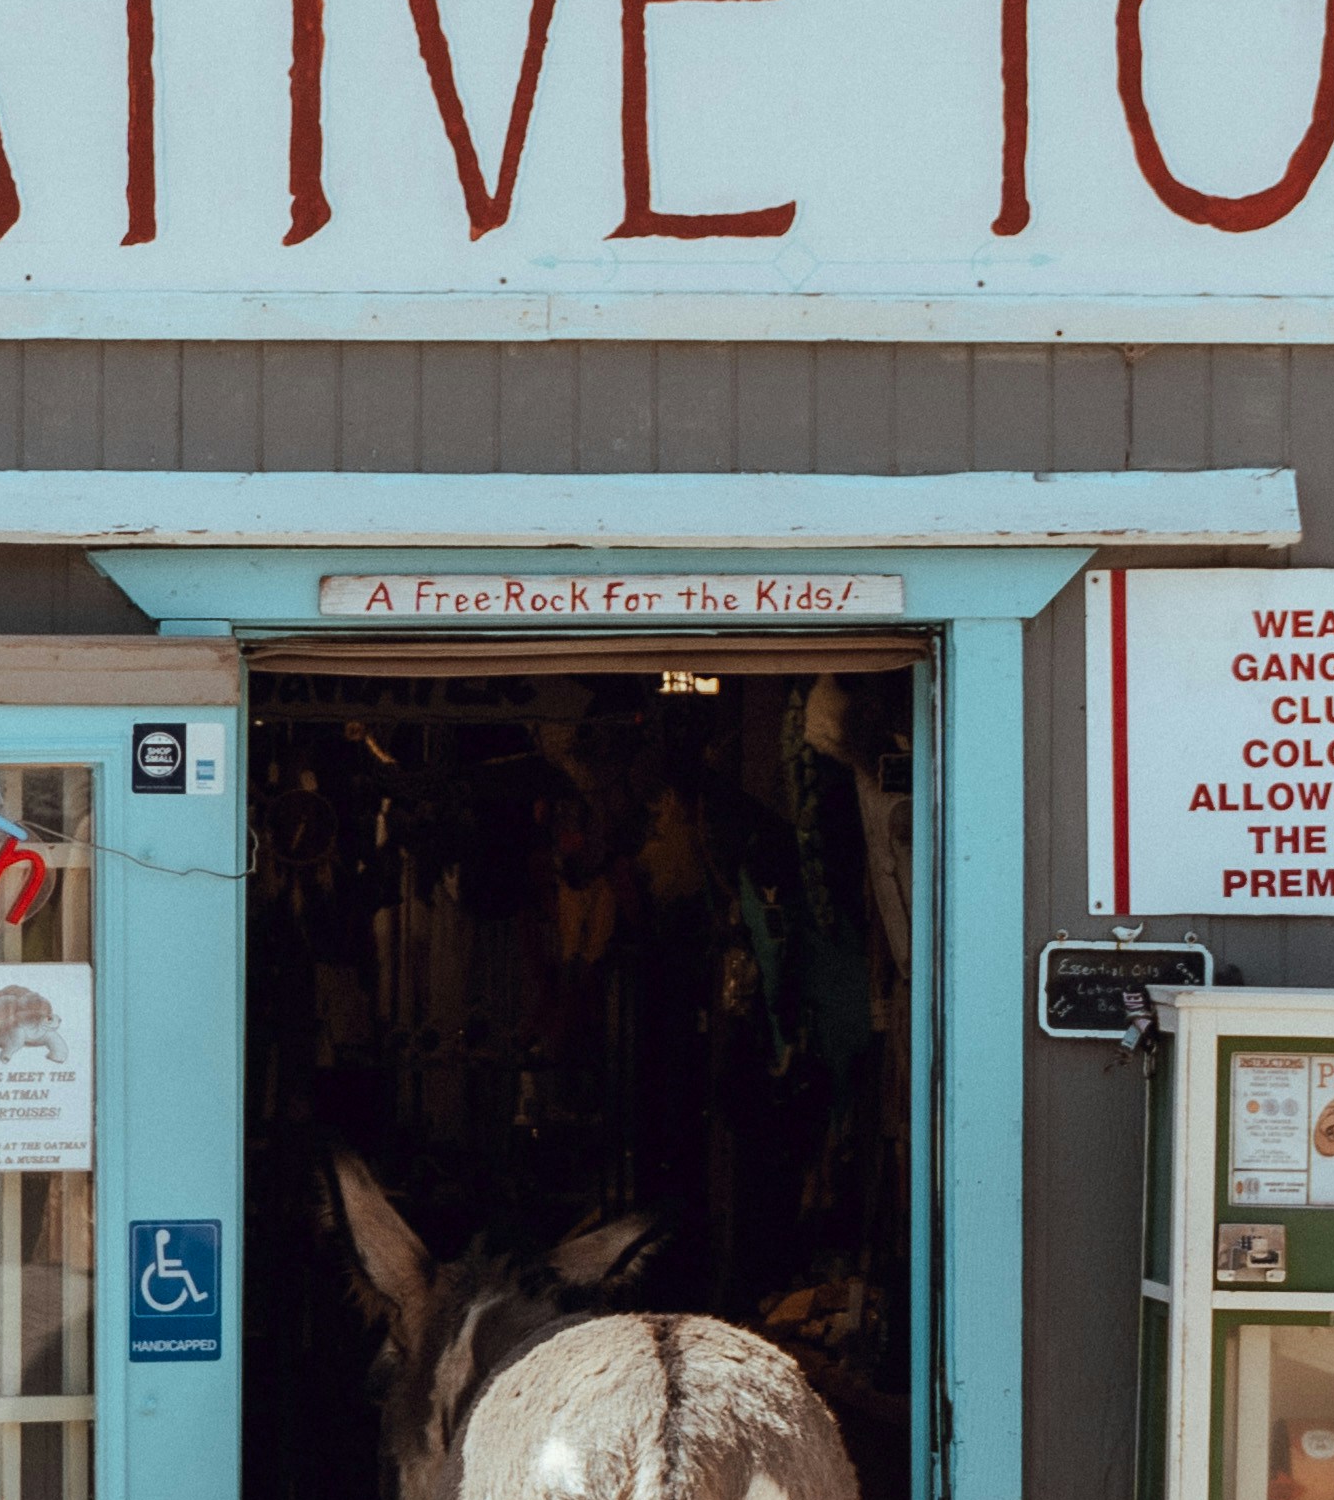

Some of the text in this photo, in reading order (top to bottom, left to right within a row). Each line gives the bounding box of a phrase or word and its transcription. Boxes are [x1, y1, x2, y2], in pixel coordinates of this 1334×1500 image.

[366, 581, 393, 612] A
[414, 581, 492, 612] Free
[504, 580, 591, 612] Rock
[677, 581, 740, 612] the
[755, 581, 853, 613] Kids!
[1247, 826, 1327, 854] THE
[7, 1072, 45, 1083] MEET
[50, 1071, 76, 1082] THE
[132, 1339, 217, 1352] HANDICAPPED
